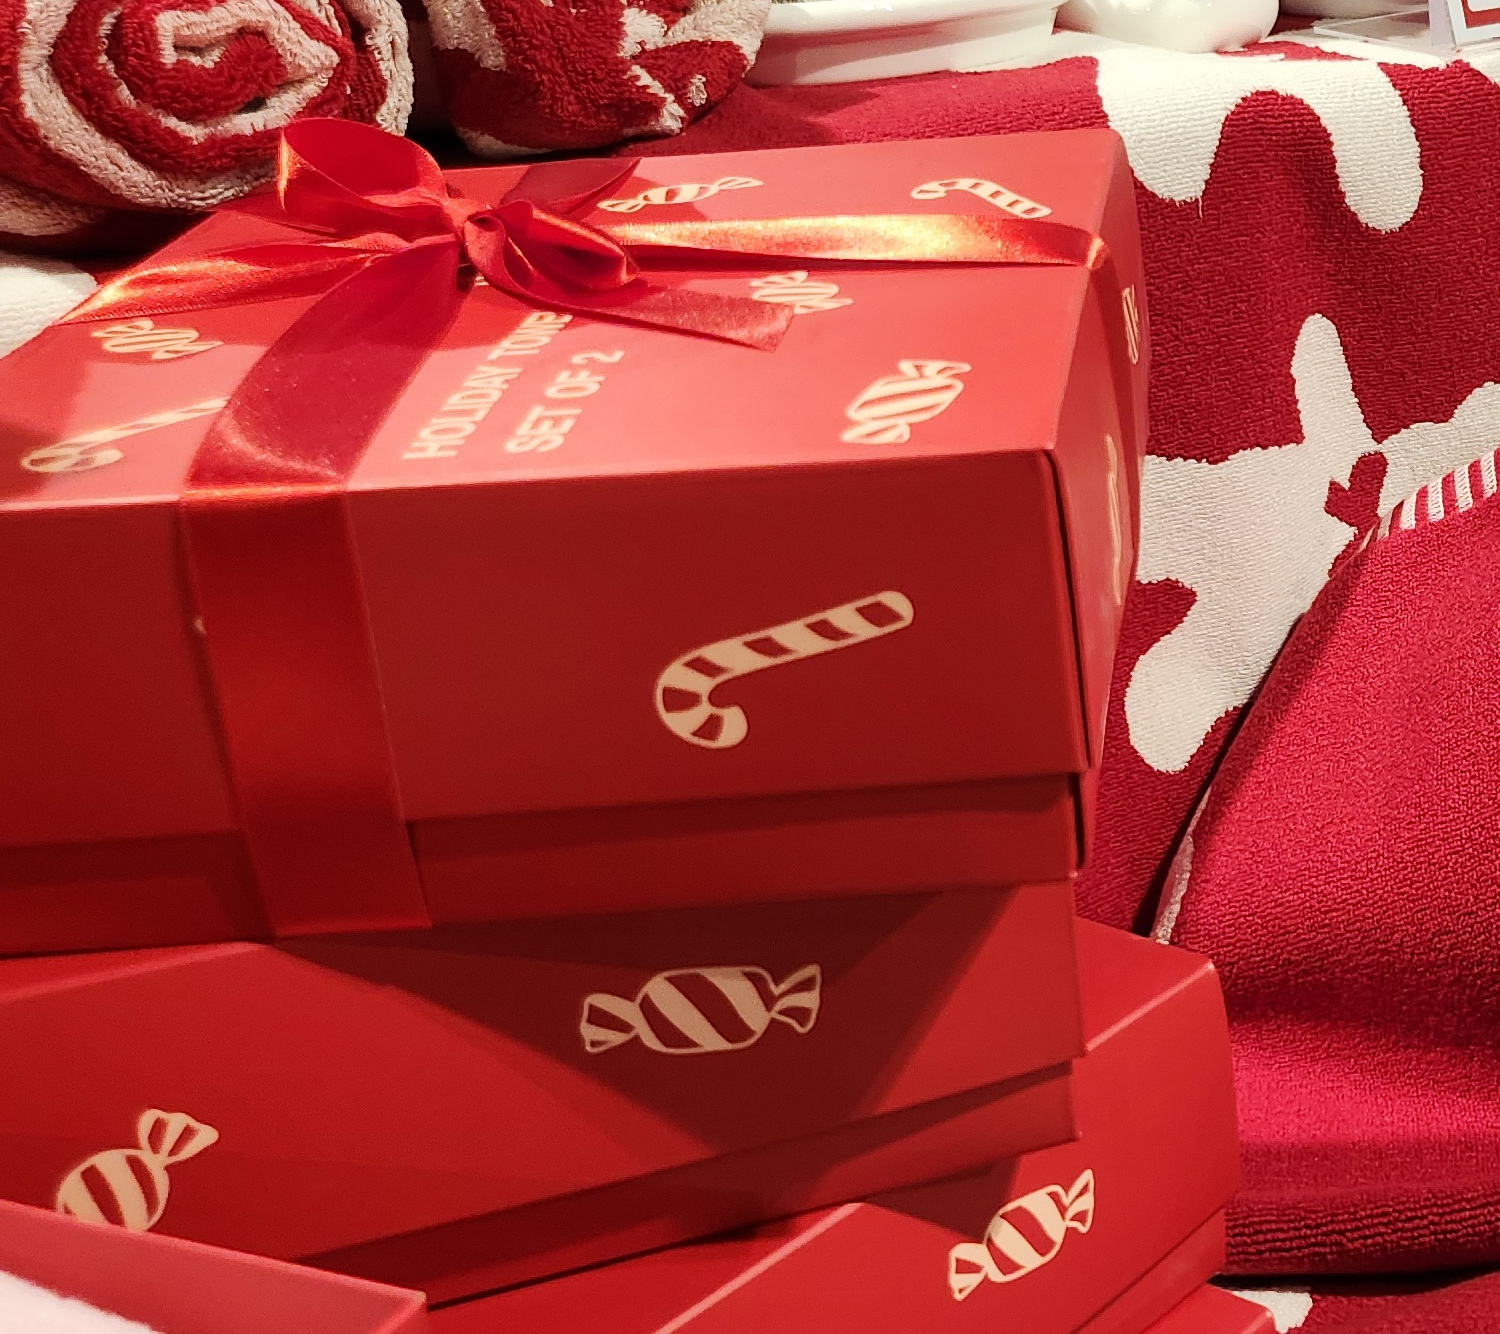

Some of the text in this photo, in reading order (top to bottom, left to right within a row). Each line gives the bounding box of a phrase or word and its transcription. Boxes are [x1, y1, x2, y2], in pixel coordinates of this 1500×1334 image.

[402, 310, 573, 459] HOLIDAY TOWE
[505, 350, 626, 453] SET OF 2
